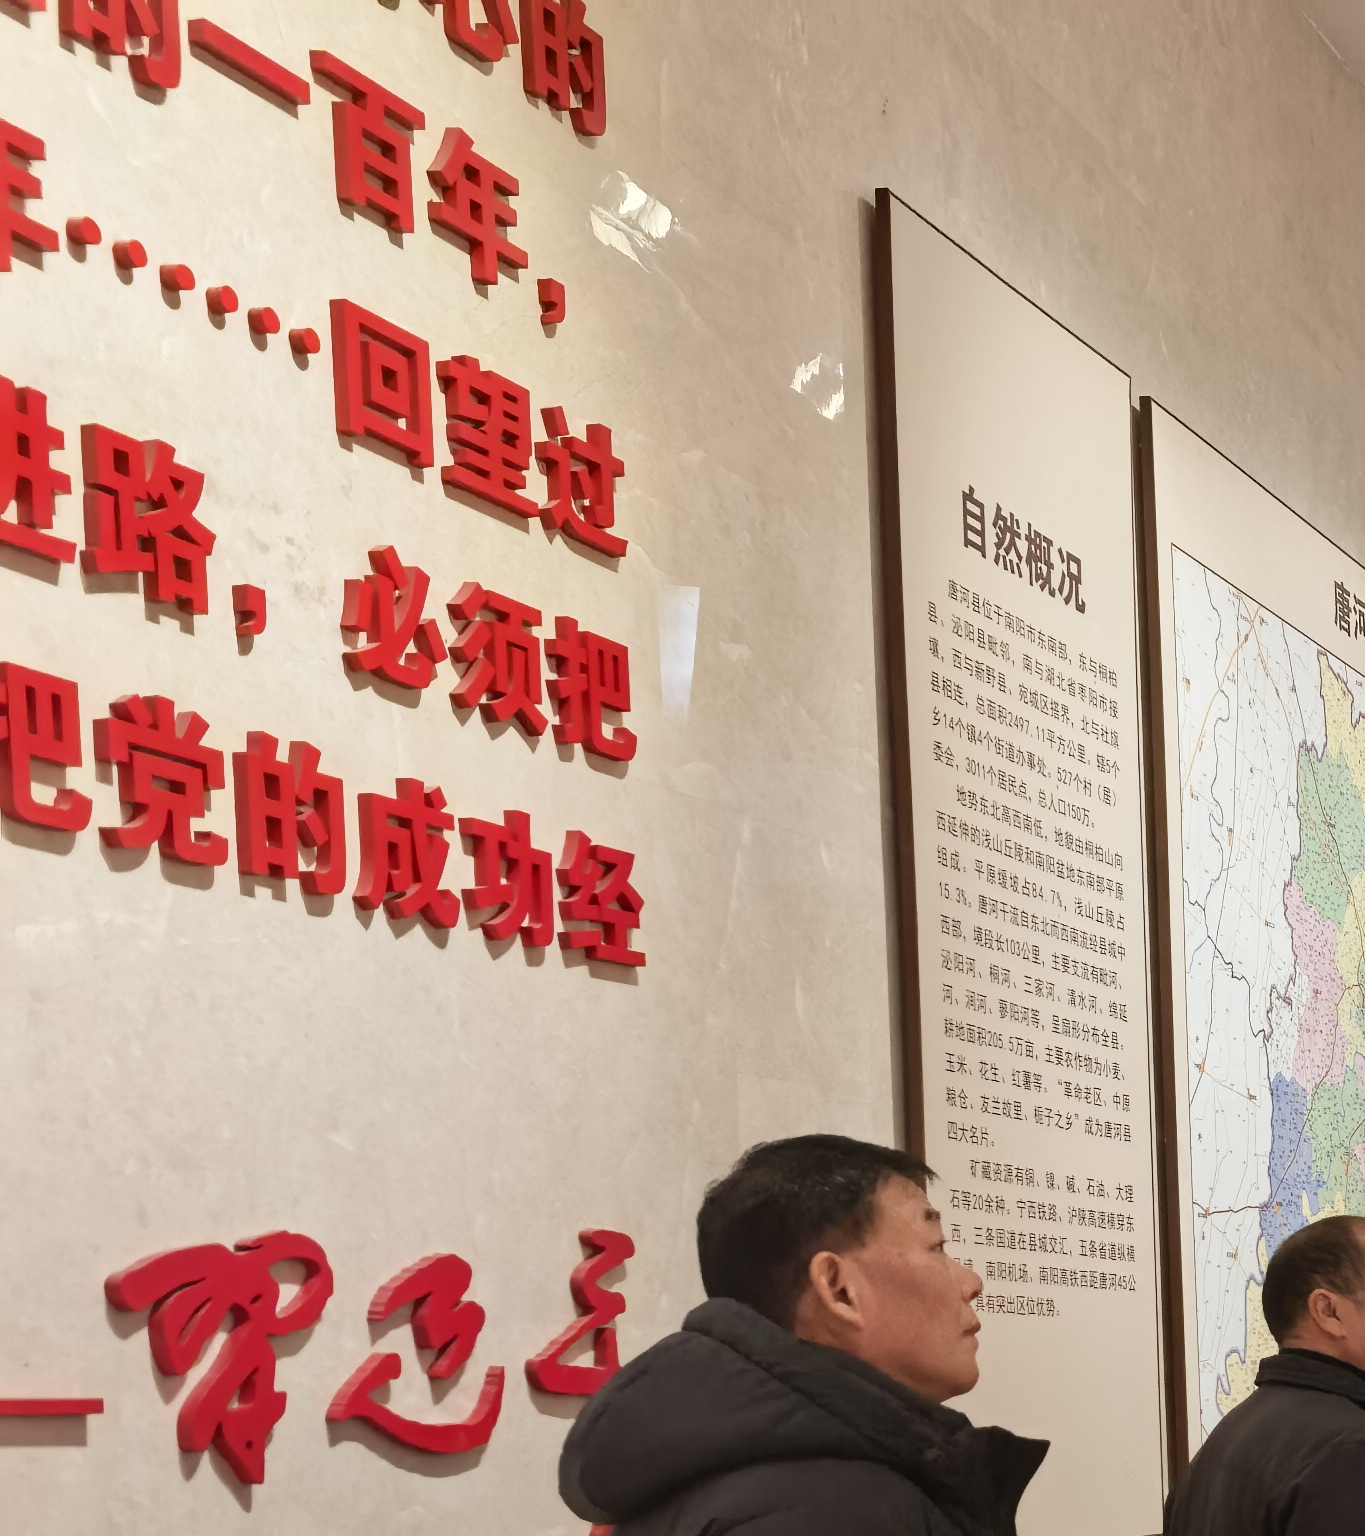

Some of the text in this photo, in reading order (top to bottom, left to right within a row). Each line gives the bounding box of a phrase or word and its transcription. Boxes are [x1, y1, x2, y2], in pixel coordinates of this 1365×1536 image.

[962, 484, 1087, 614] 自然概况
[0, 662, 646, 967] 把党的成功经
[946, 1119, 996, 1149] 四大名片。
